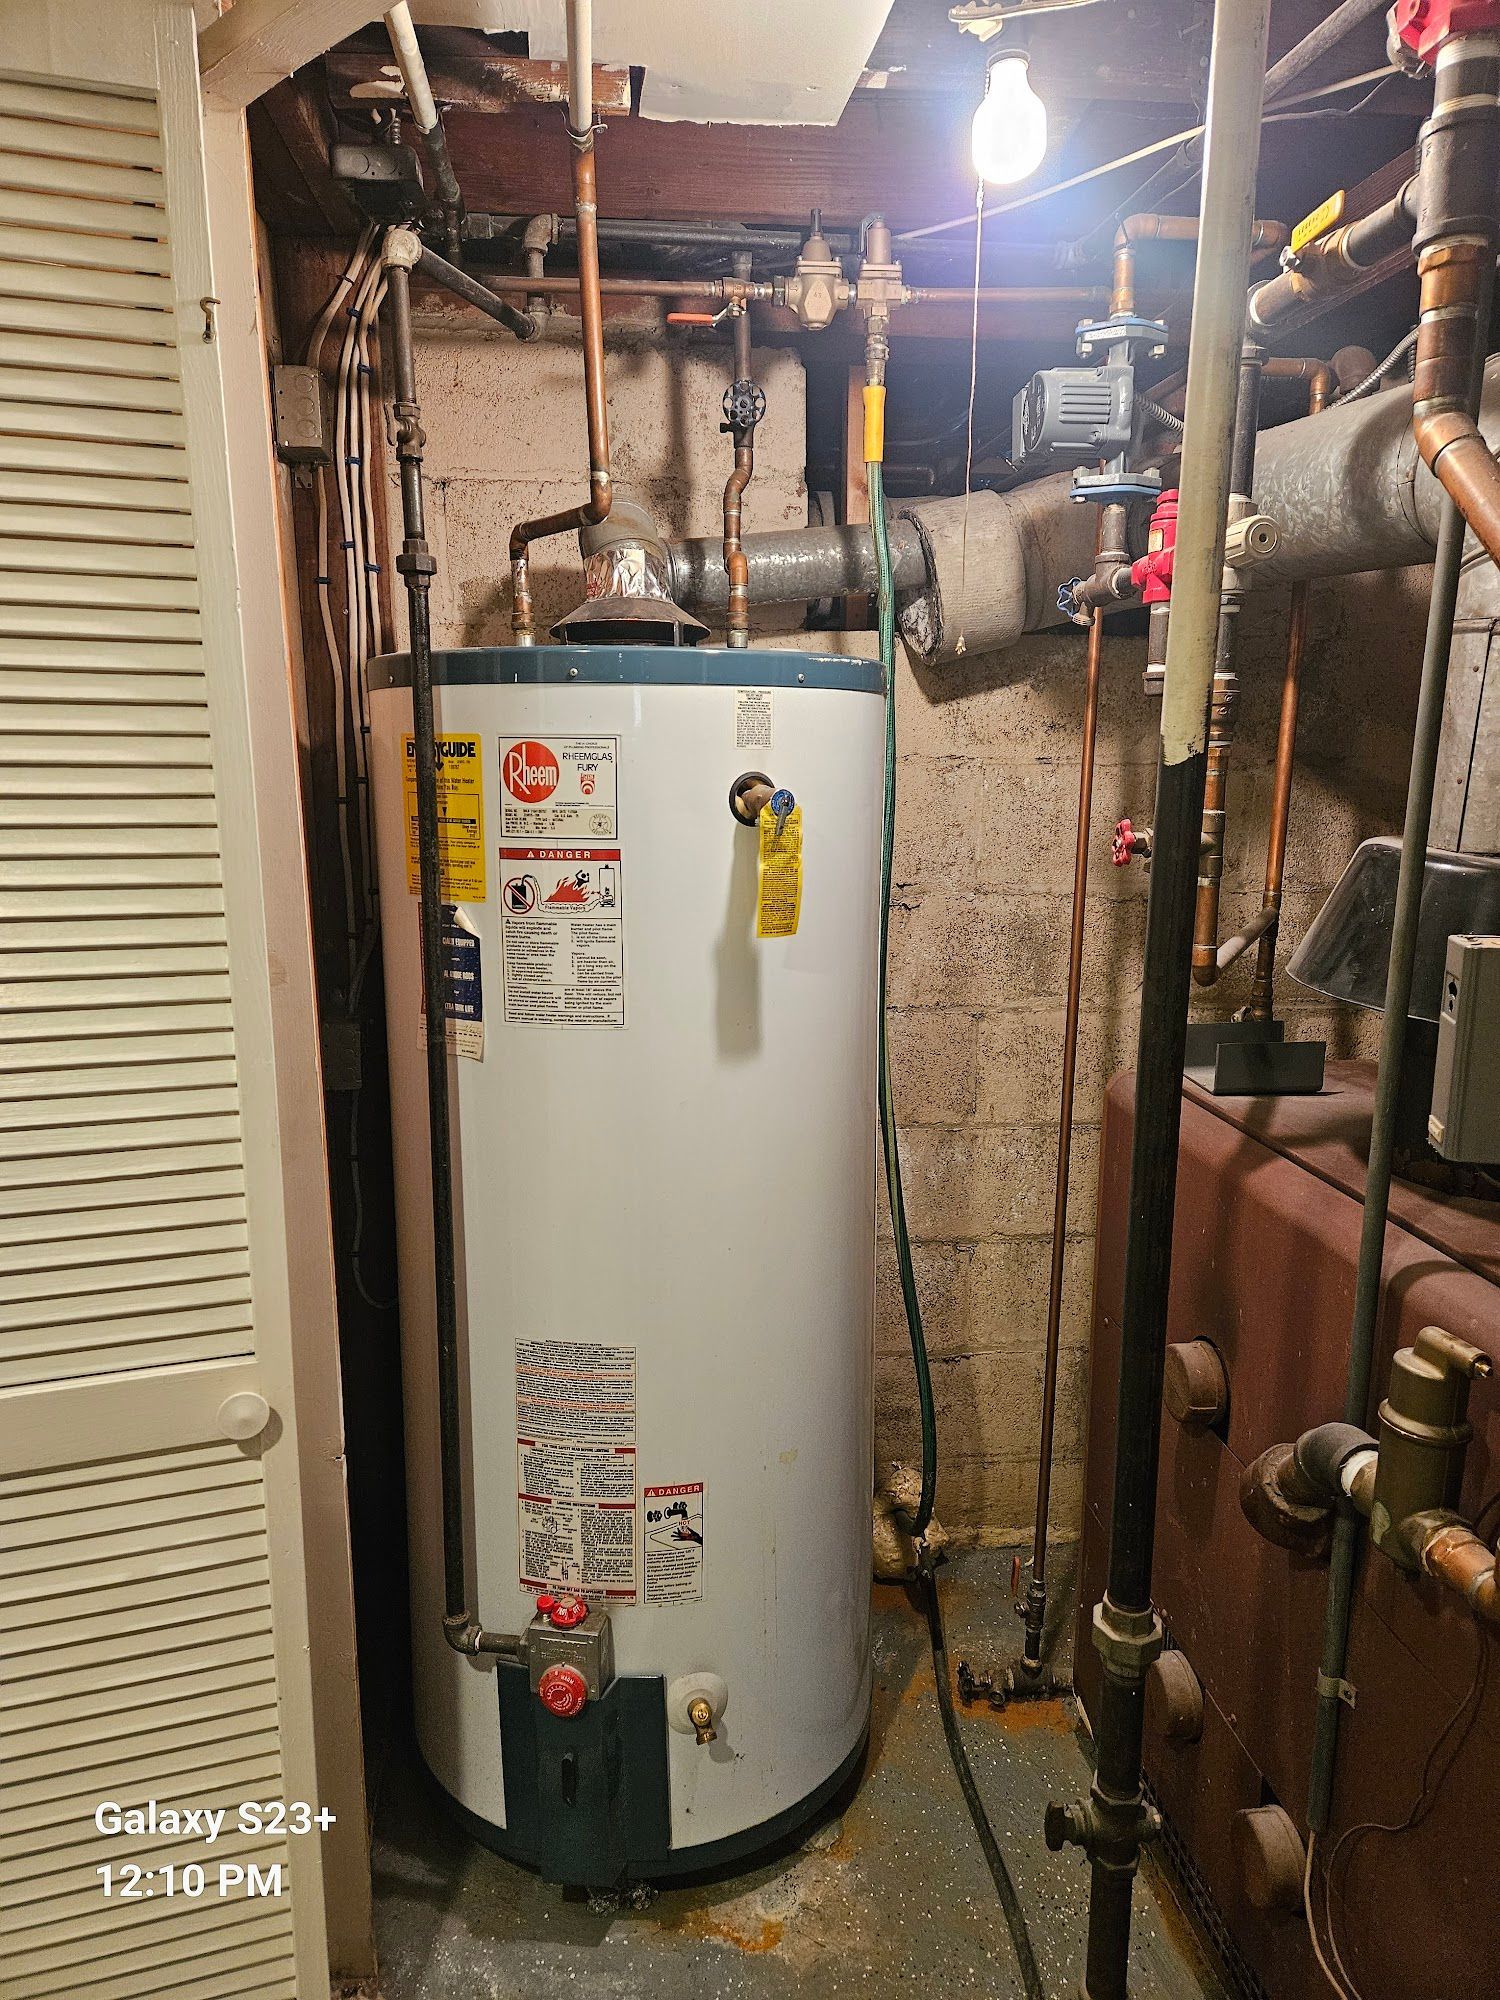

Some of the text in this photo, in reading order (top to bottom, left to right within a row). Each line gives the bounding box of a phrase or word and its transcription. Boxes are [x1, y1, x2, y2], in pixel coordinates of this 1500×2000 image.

[562, 752, 612, 761] RHEEMGLAS
[509, 744, 556, 794] Rheem
[659, 1485, 699, 1495] DANGER
